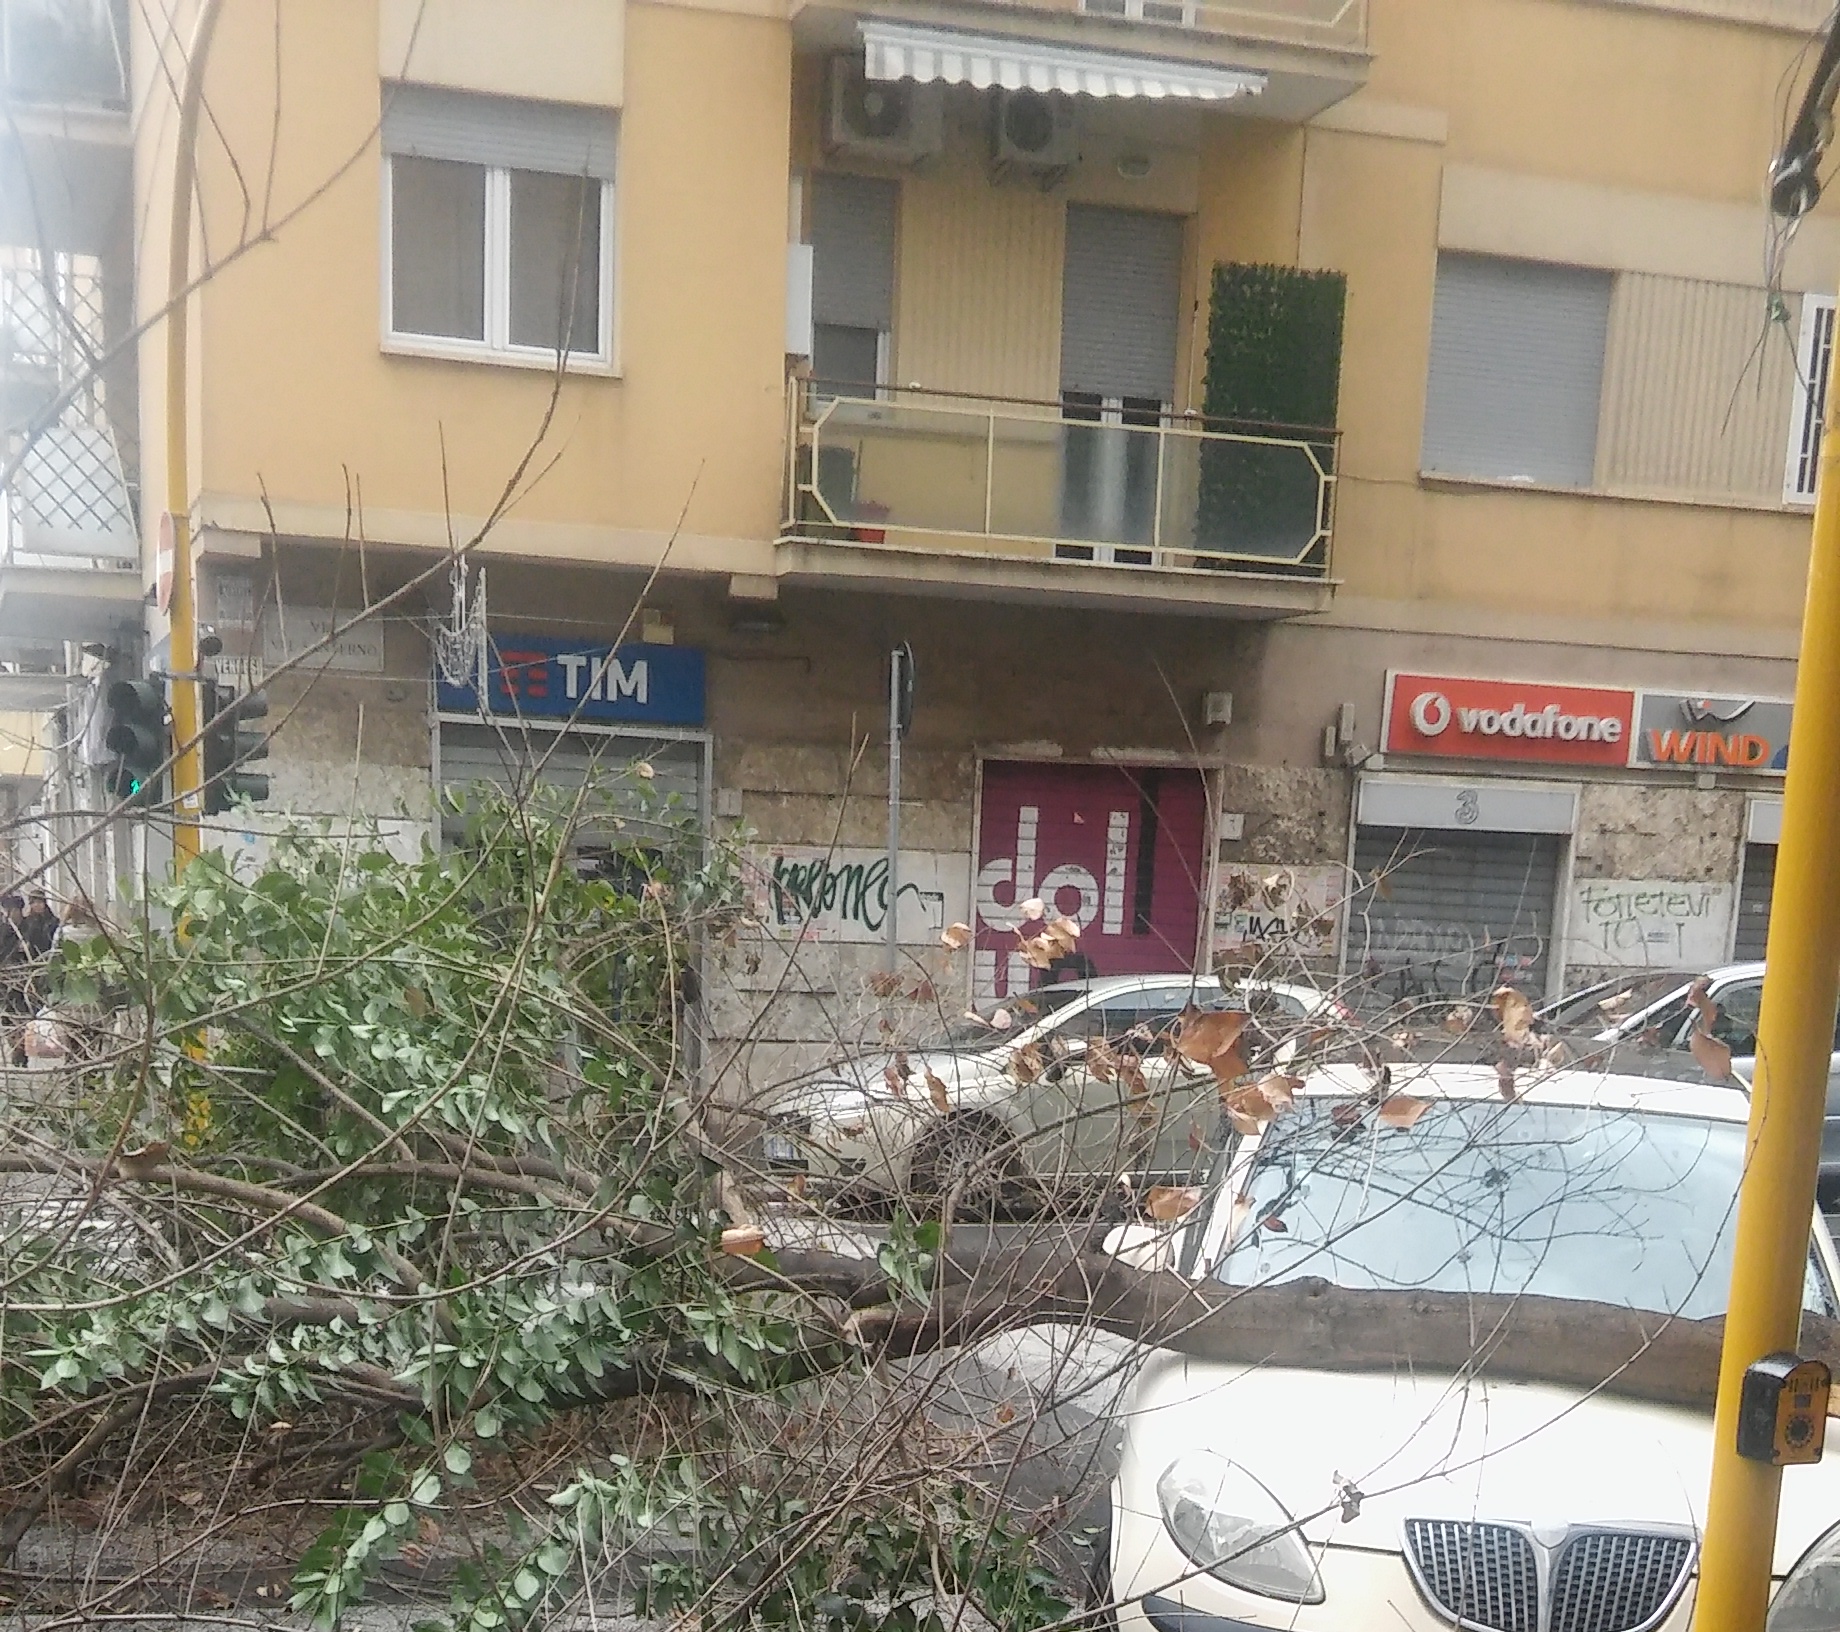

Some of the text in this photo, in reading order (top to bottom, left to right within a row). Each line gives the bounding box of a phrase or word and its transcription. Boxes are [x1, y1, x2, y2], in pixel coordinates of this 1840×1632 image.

[556, 653, 649, 704] TIM
[1458, 703, 1622, 744] vodafone
[1650, 729, 1771, 768] WIND
[1454, 789, 1480, 825] 3
